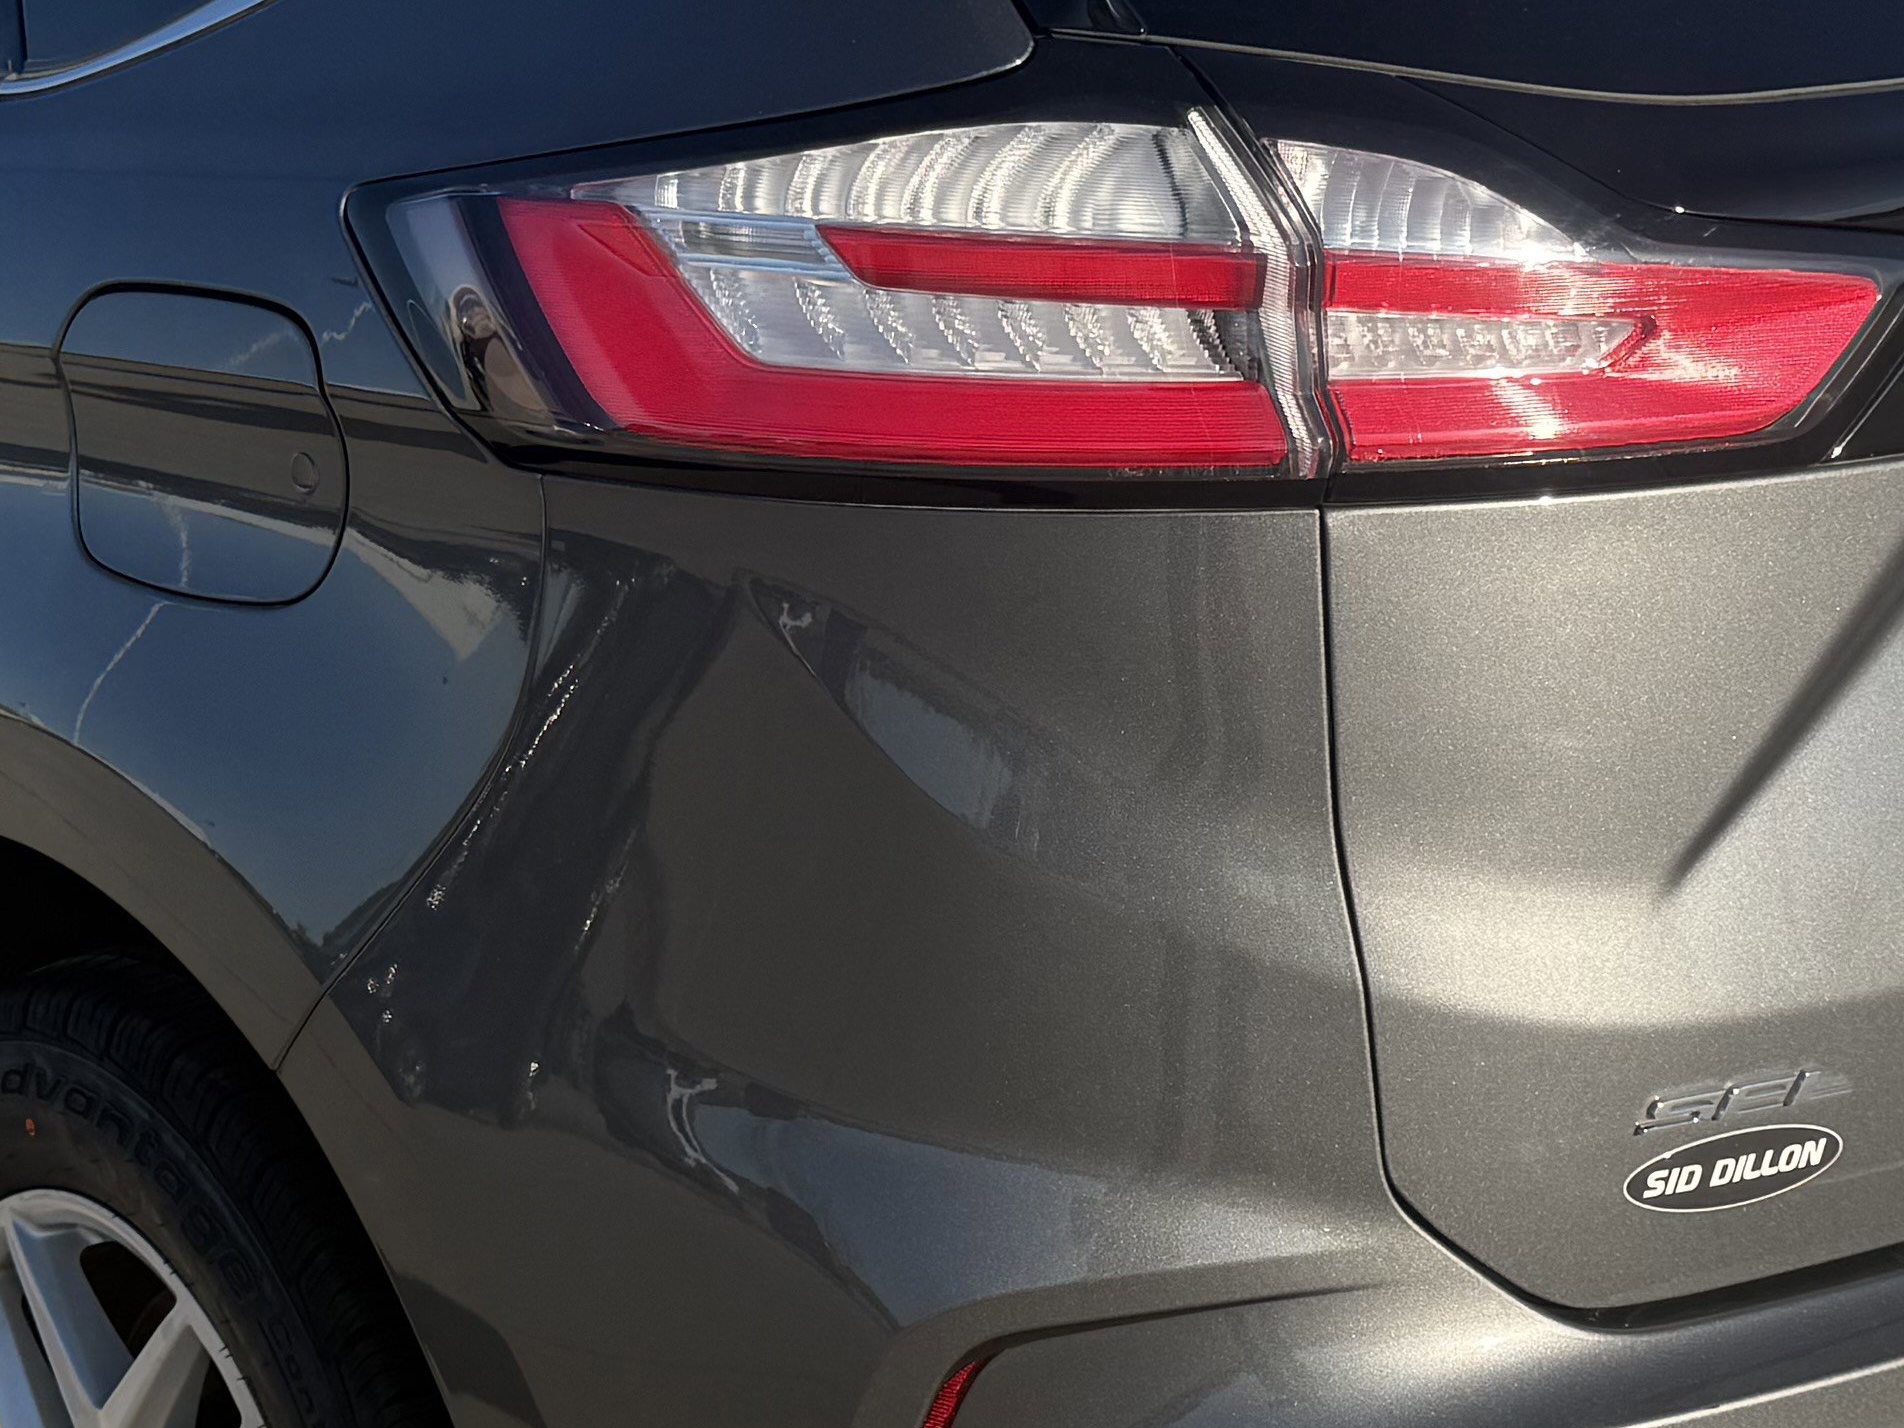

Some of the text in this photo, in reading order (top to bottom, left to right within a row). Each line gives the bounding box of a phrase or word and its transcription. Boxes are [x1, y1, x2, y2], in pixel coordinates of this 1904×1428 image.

[1633, 1069, 1852, 1136] SEL
[1643, 1137, 1827, 1199] SID DILLON
